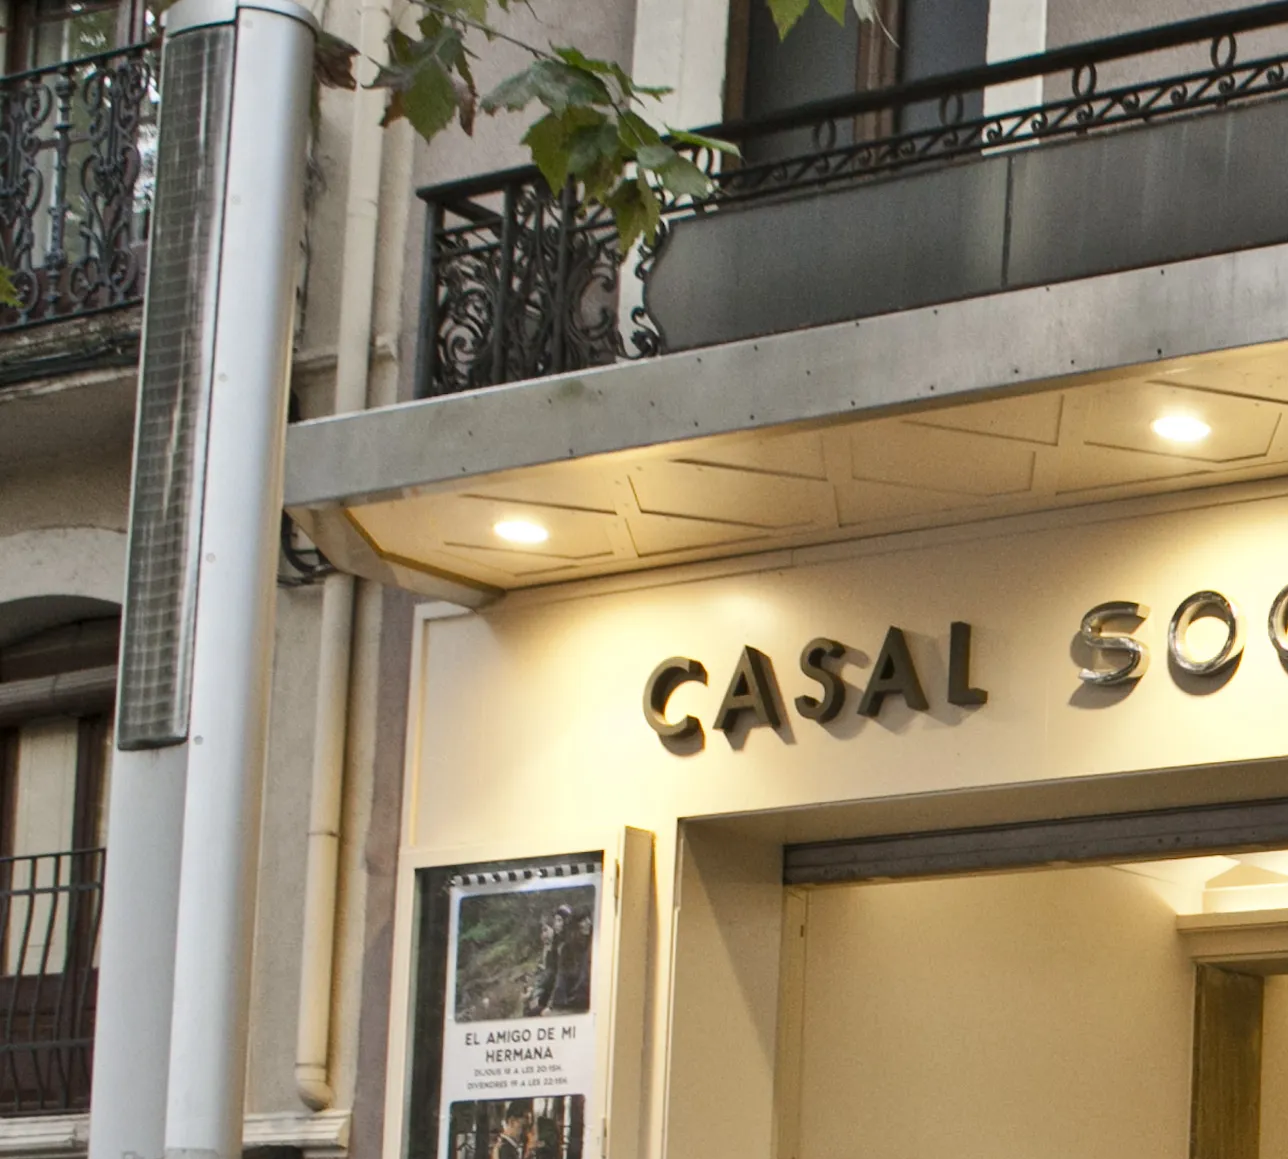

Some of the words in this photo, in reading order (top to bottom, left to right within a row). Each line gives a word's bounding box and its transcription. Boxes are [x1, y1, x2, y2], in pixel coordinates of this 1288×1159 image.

[643, 621, 988, 737] CASAL
[465, 1033, 480, 1046] EL
[486, 1029, 532, 1044] AMIGO
[537, 1028, 555, 1041] DE
[562, 1026, 576, 1039] MI
[486, 1047, 554, 1062] HERMANA
